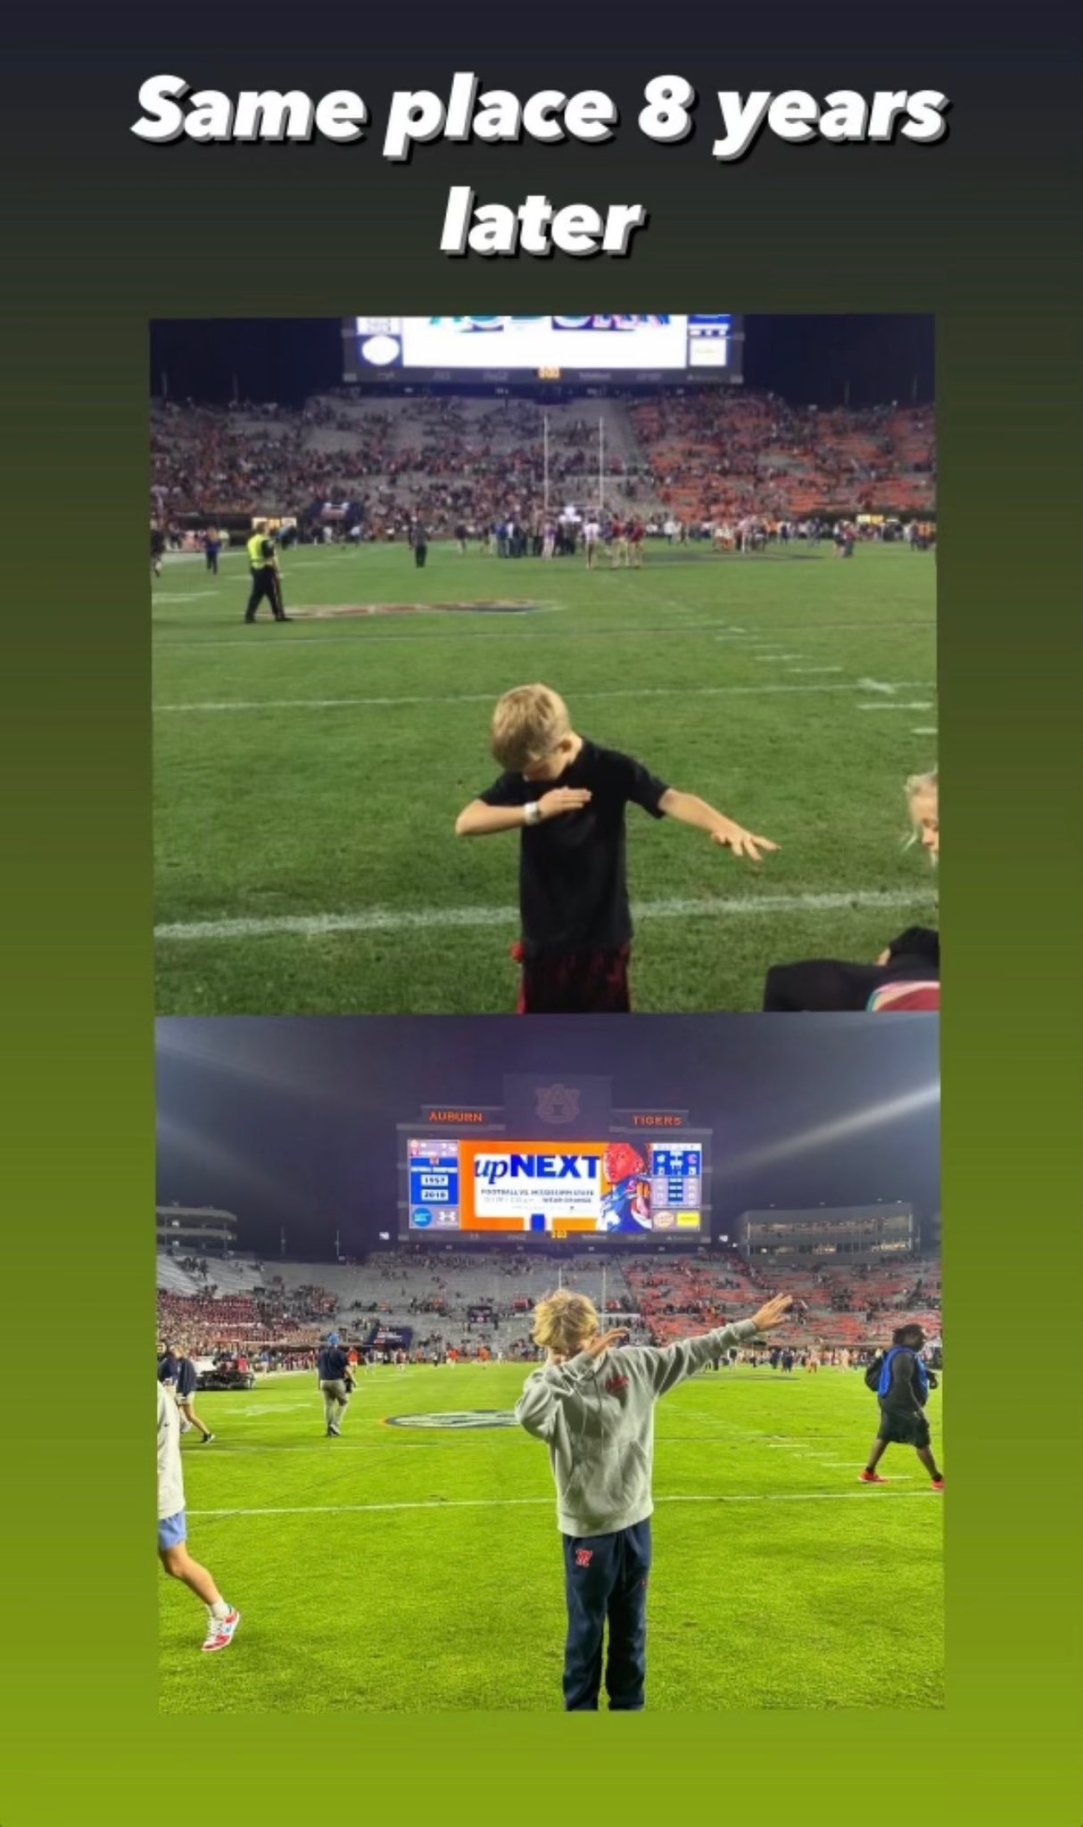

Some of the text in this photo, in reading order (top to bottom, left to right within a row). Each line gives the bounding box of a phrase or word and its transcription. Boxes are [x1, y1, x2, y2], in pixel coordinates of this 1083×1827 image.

[429, 1111, 482, 1122] AUBURN
[633, 1115, 682, 1126] TIGERS
[475, 1155, 600, 1185] upNEXT
